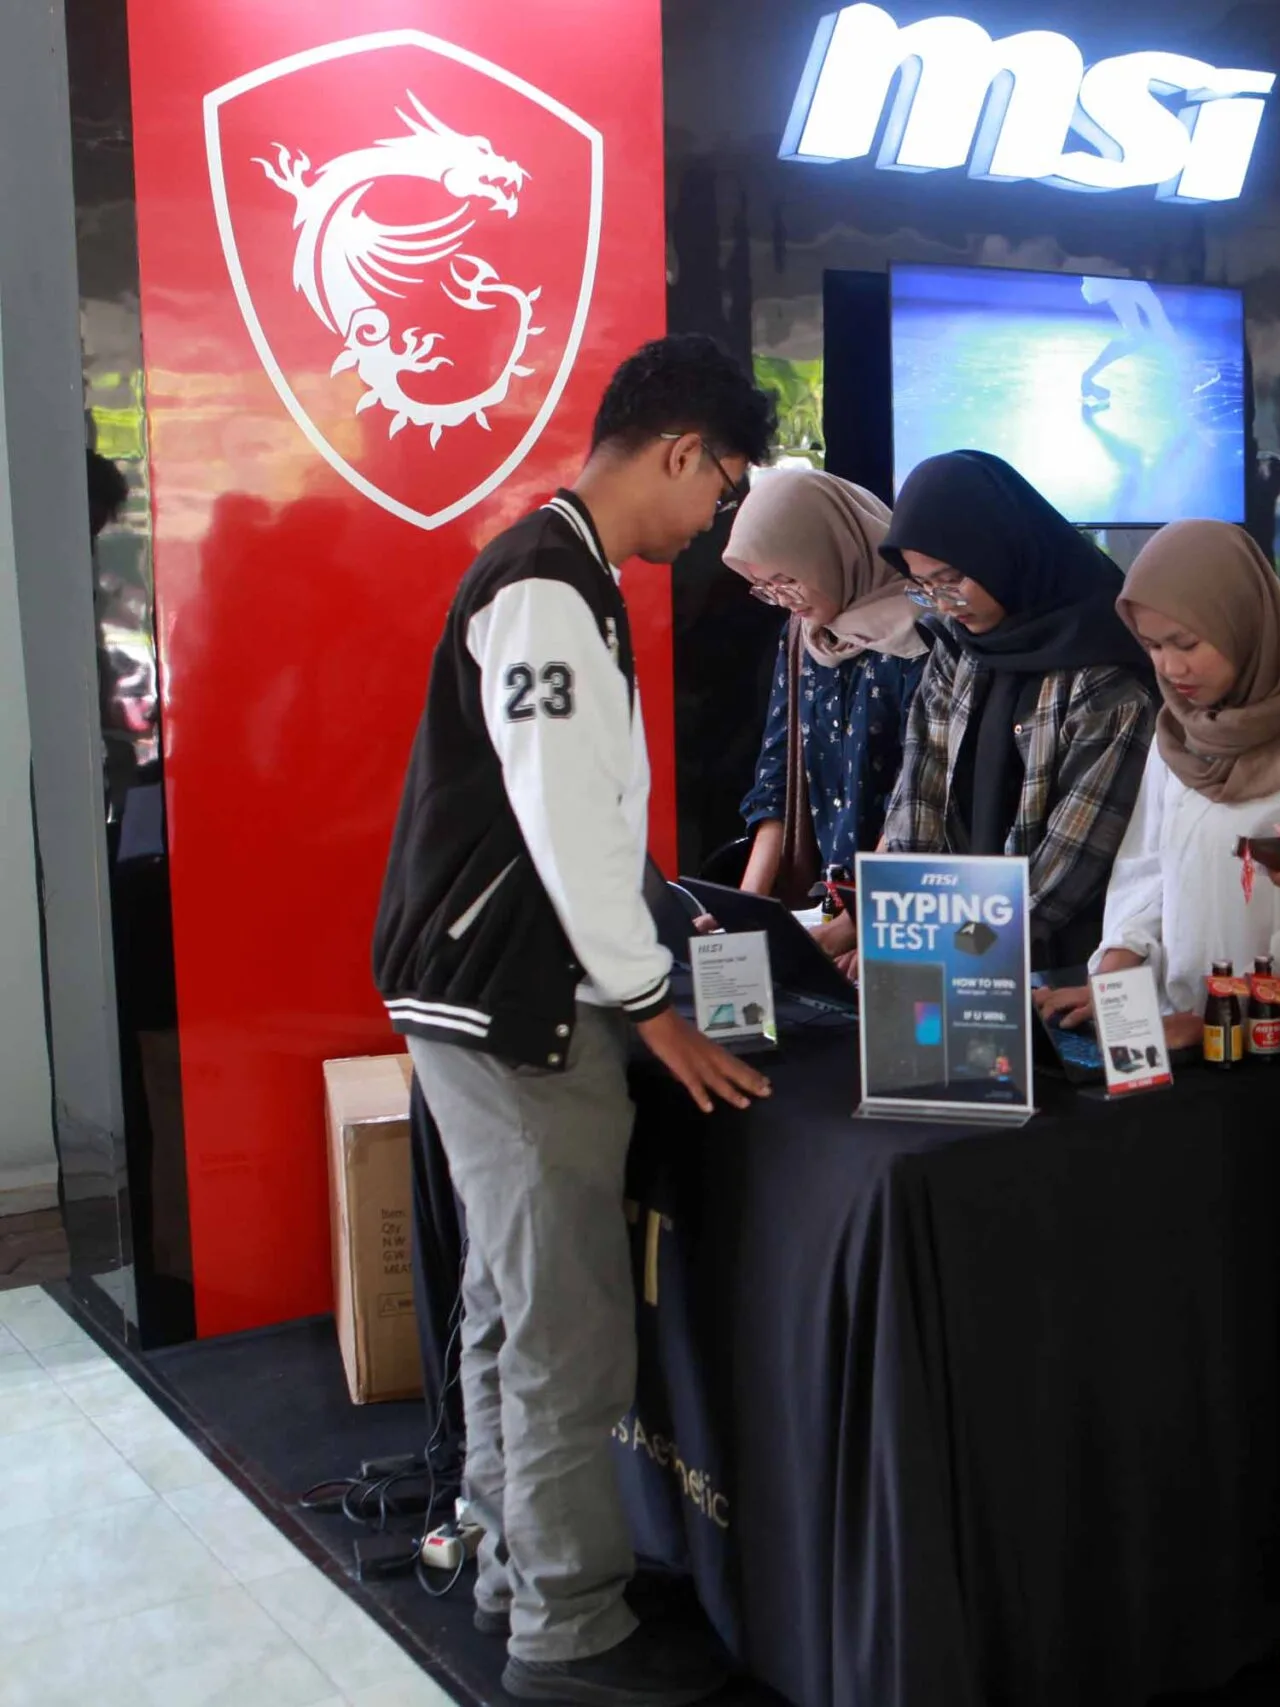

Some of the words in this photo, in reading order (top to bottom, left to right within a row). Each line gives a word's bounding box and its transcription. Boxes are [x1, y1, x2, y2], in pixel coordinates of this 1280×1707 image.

[503, 661, 576, 723] 23
[870, 891, 1014, 926] TYPING
[872, 922, 941, 950] TEST
[978, 978, 992, 989] TO
